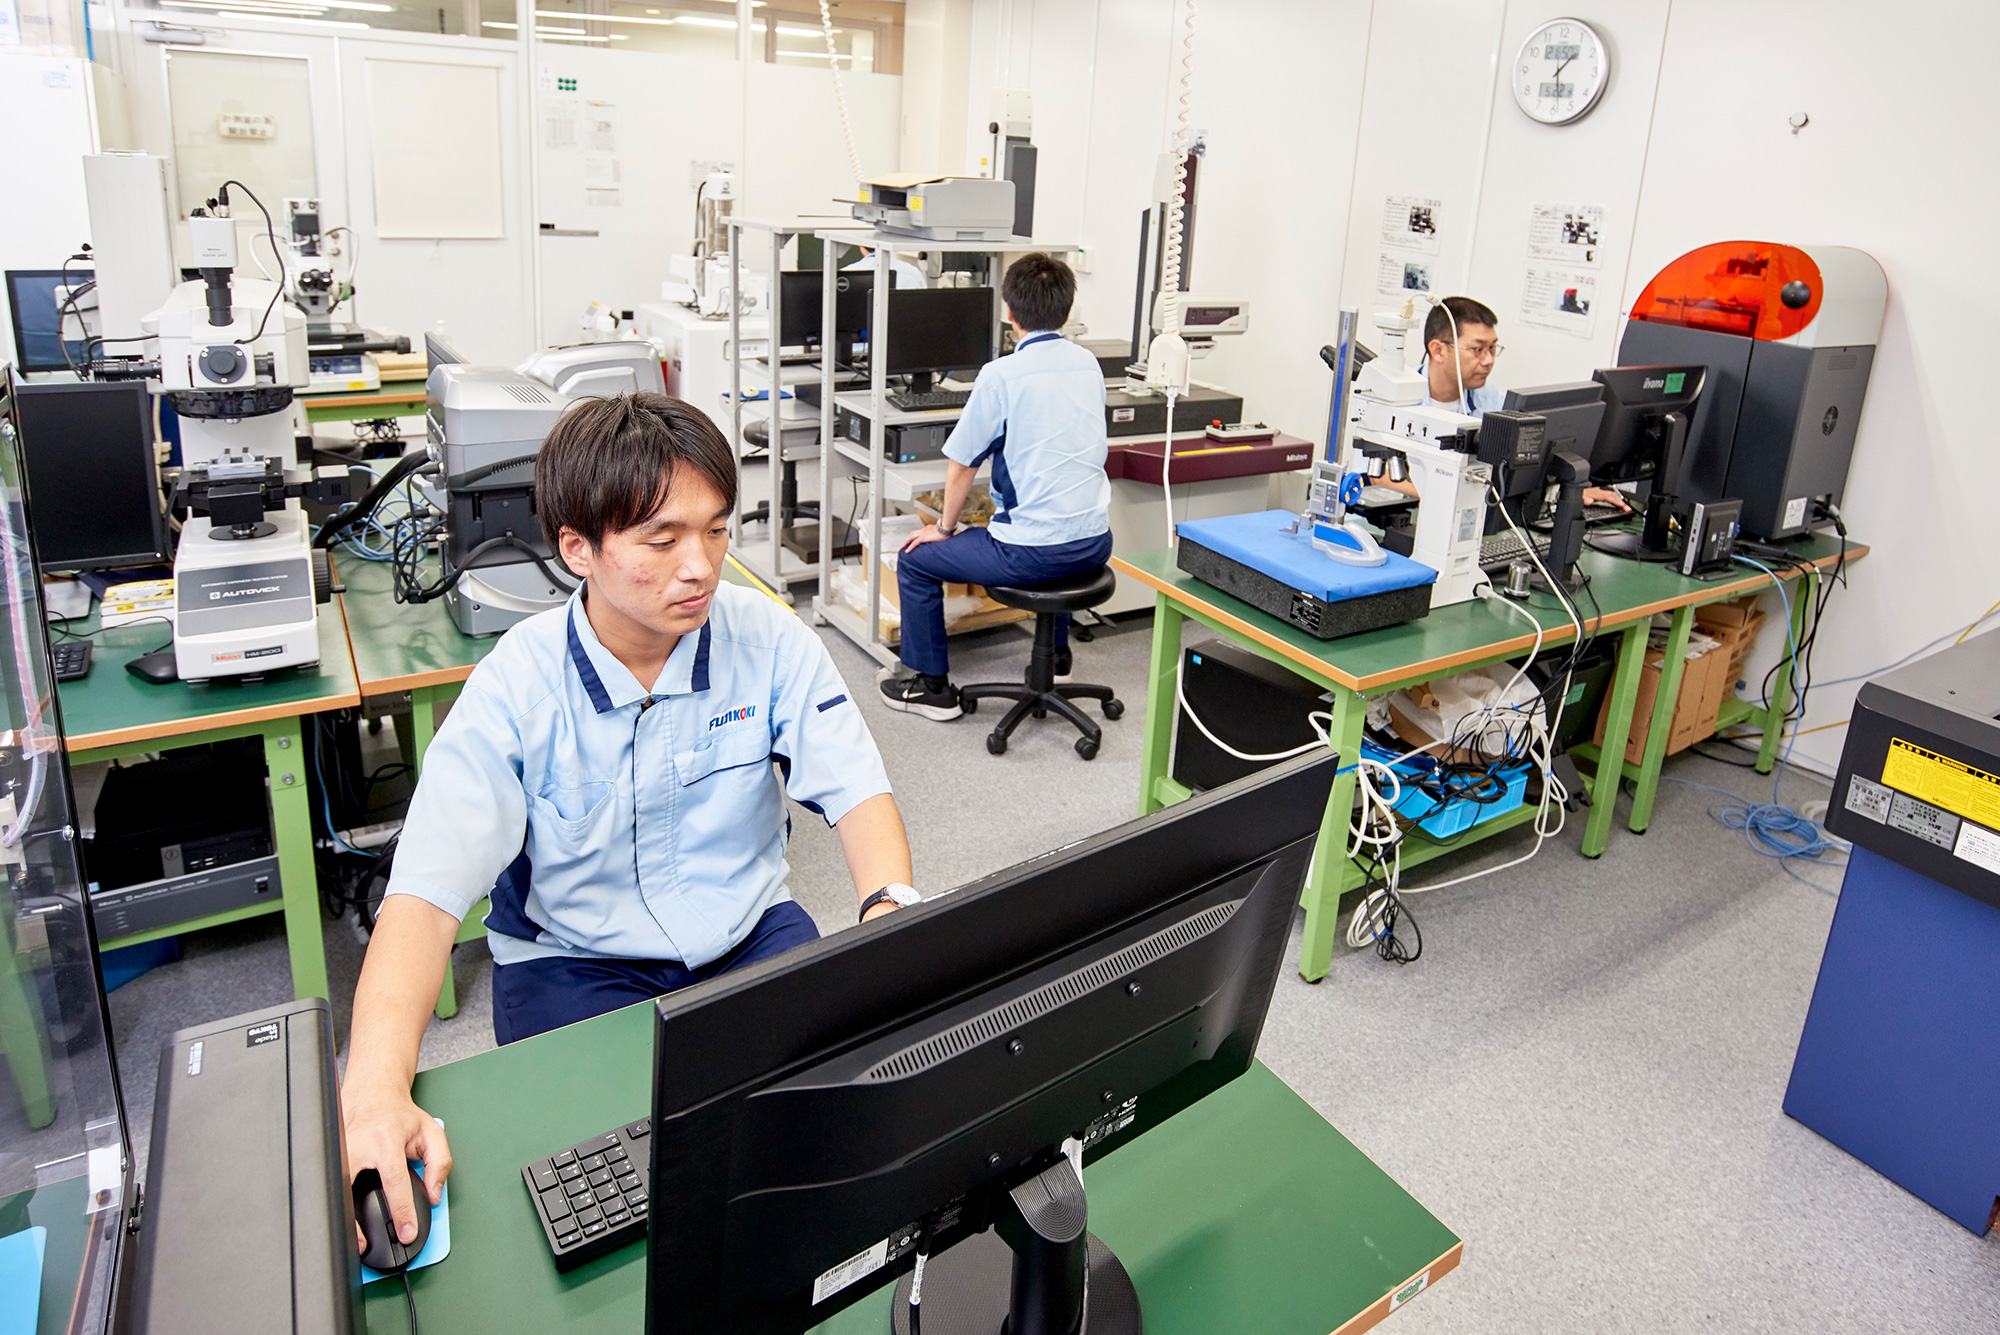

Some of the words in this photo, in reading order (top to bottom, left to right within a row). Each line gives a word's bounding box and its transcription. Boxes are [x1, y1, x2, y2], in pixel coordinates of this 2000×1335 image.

[1544, 31, 1552, 43] 11
[1560, 27, 1570, 38] 12
[1530, 47, 1540, 58] 10
[1589, 47, 1597, 58] 2
[1522, 65, 1529, 76] 9
[1591, 66, 1598, 78] 3
[1524, 85, 1531, 96] 8
[1582, 88, 1589, 97] 4
[1549, 105, 1556, 115] 6
[1567, 101, 1574, 111] 5
[1435, 467, 1454, 478] Nikon
[222, 585, 281, 598] AUTOVICK
[216, 653, 242, 662] Mitutoyo
[246, 647, 282, 658] HM-200
[708, 705, 756, 732] FUJIKOKI
[1941, 757, 1969, 774] WARNING
[134, 888, 169, 899] AUTOVICK
[248, 1023, 278, 1036] TOKYO
[255, 1033, 278, 1044] Made
